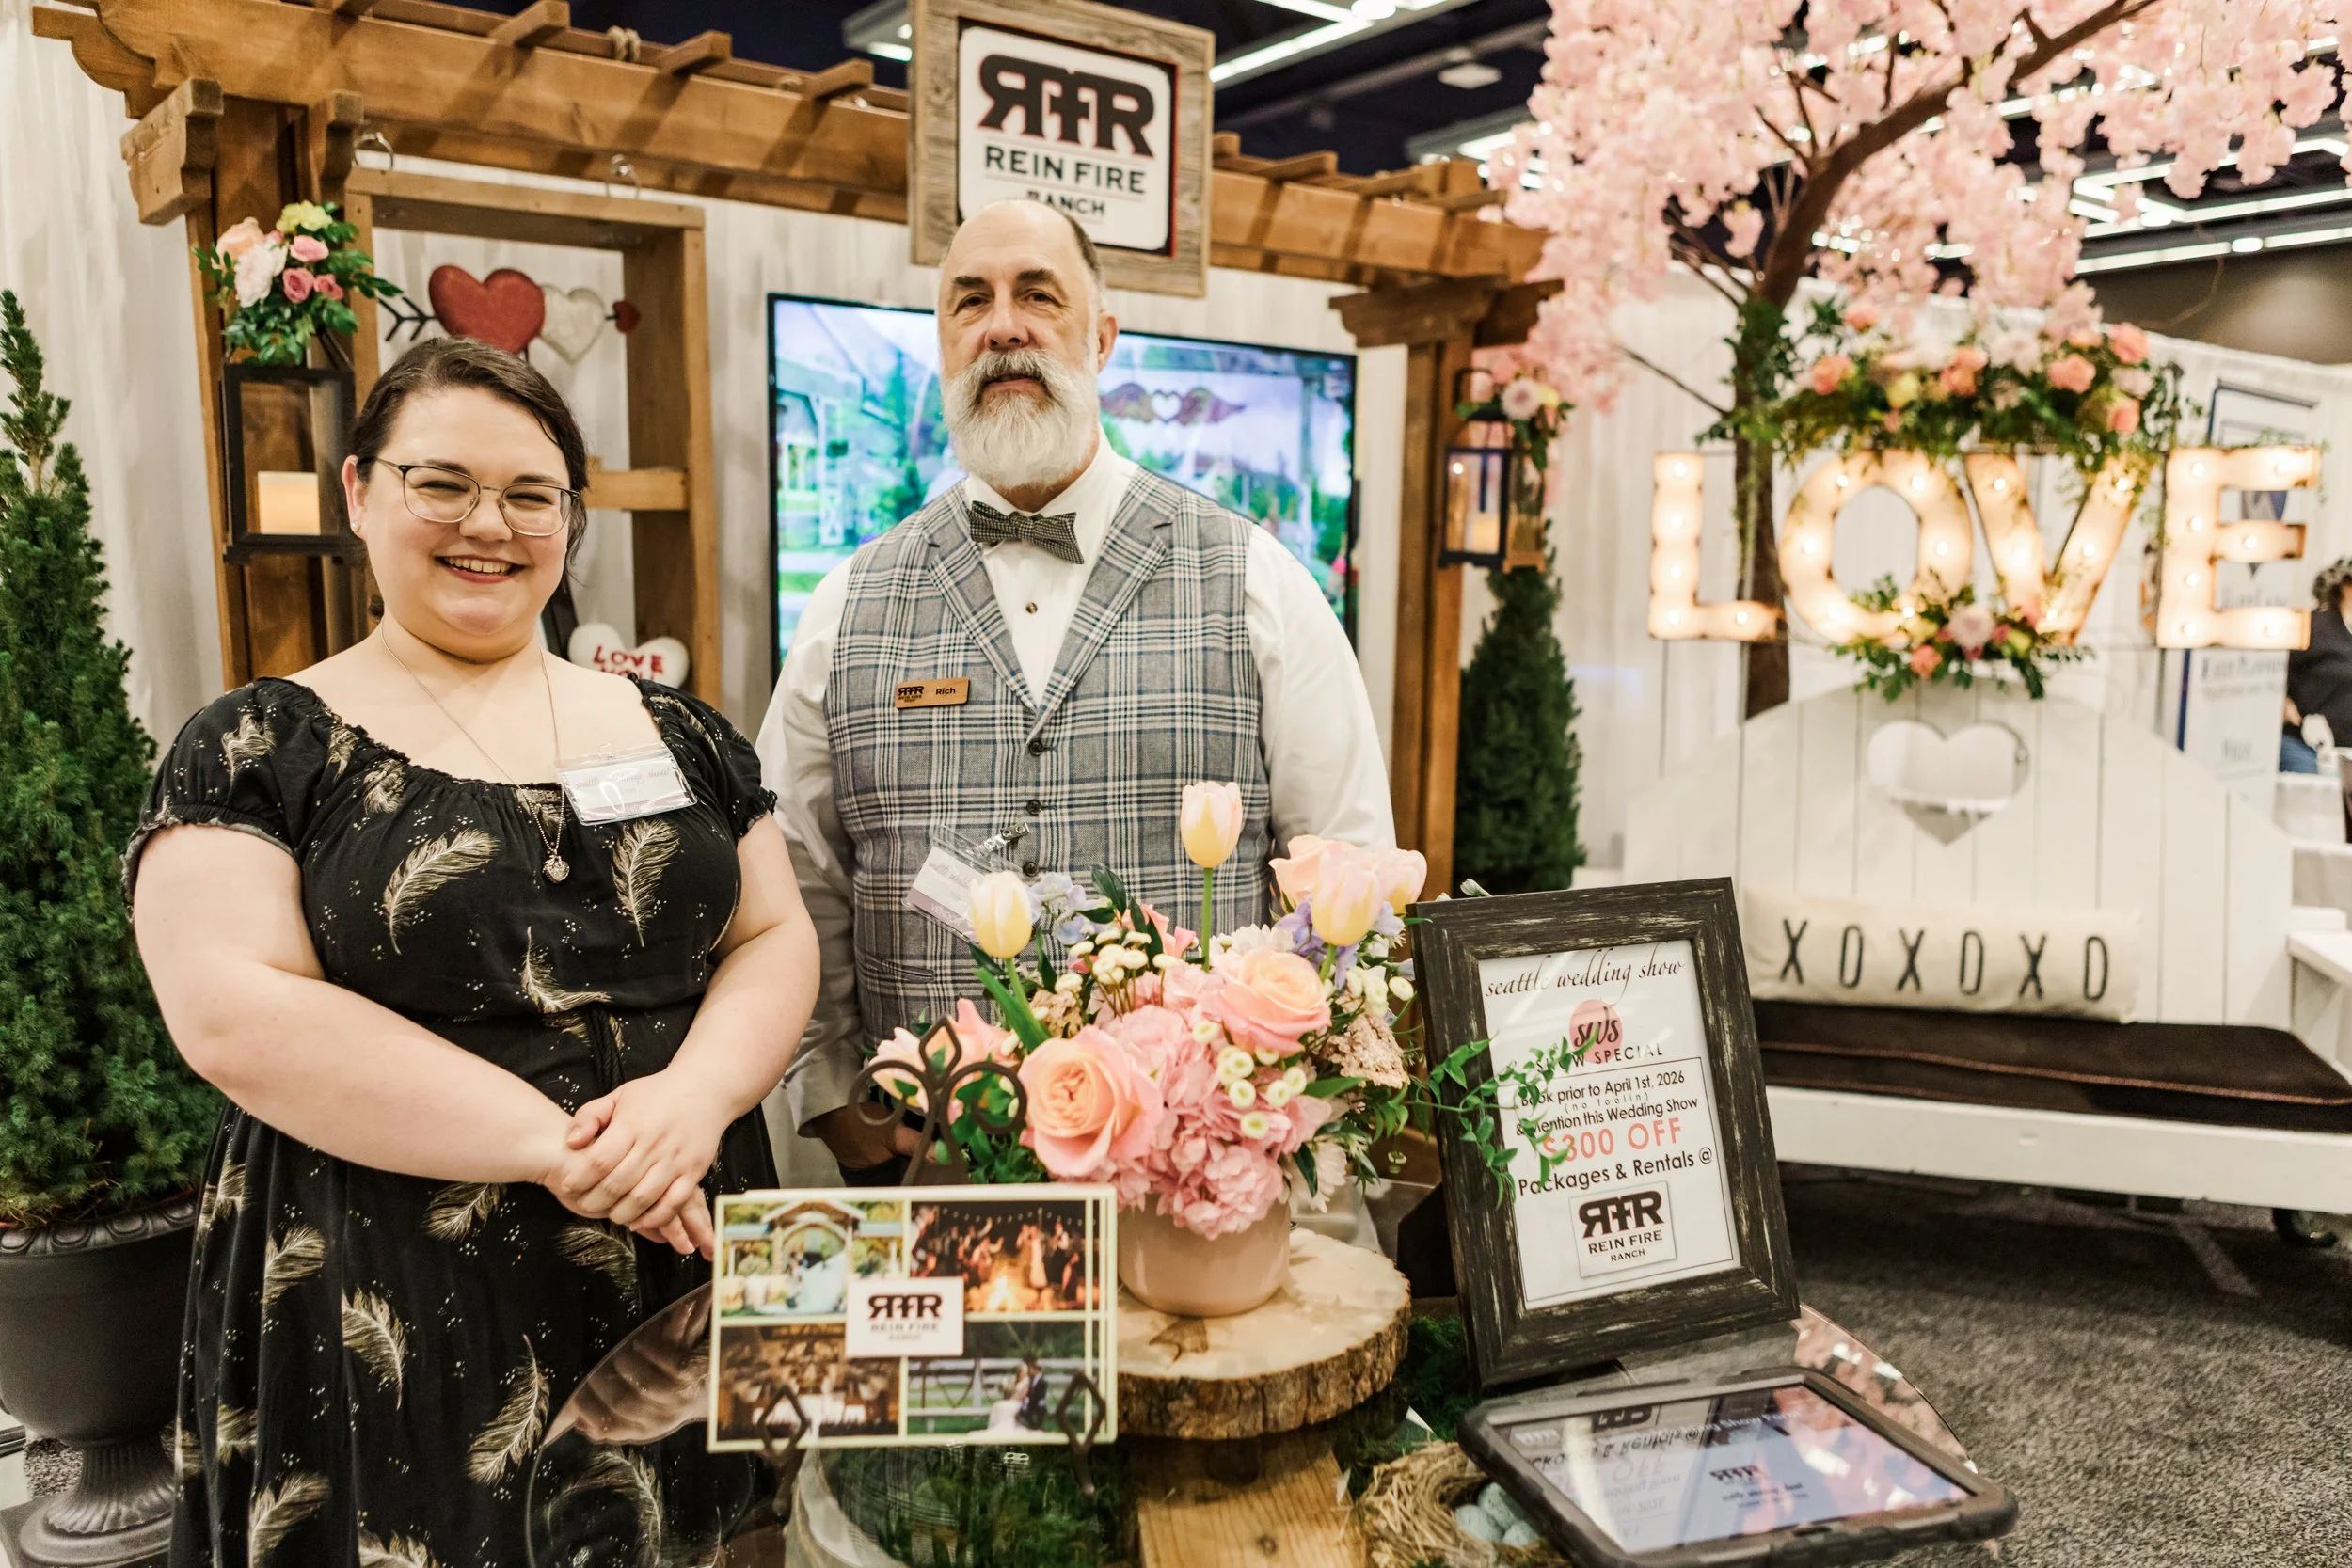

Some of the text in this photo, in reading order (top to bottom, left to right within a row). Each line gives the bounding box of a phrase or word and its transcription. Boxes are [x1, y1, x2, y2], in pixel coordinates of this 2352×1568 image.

[985, 145, 1146, 195] REIN FIRE
[1647, 446, 2321, 651] LOVE
[593, 645, 663, 673] LOVE
[935, 687, 957, 695] Rich
[1485, 941, 1685, 1006] seattle wedding show
[1594, 1043, 1663, 1065] SPECIAL
[1557, 1085, 1586, 1104] prior
[1588, 1083, 1601, 1097] to
[1604, 1077, 1633, 1097] April
[1635, 1075, 1655, 1090] 1st,
[1656, 1069, 1686, 1087] 2026
[1565, 1102, 1588, 1114] (no
[1583, 1110, 1605, 1126] this
[1606, 1101, 1664, 1122] Wedding
[1666, 1097, 1699, 1113] Show
[1627, 1117, 1682, 1150] OFF
[1518, 1147, 1713, 1196] Packages & Rentals @
[1588, 1229, 1663, 1255] REIN FIRE
[1610, 1249, 1646, 1262] RANCH
